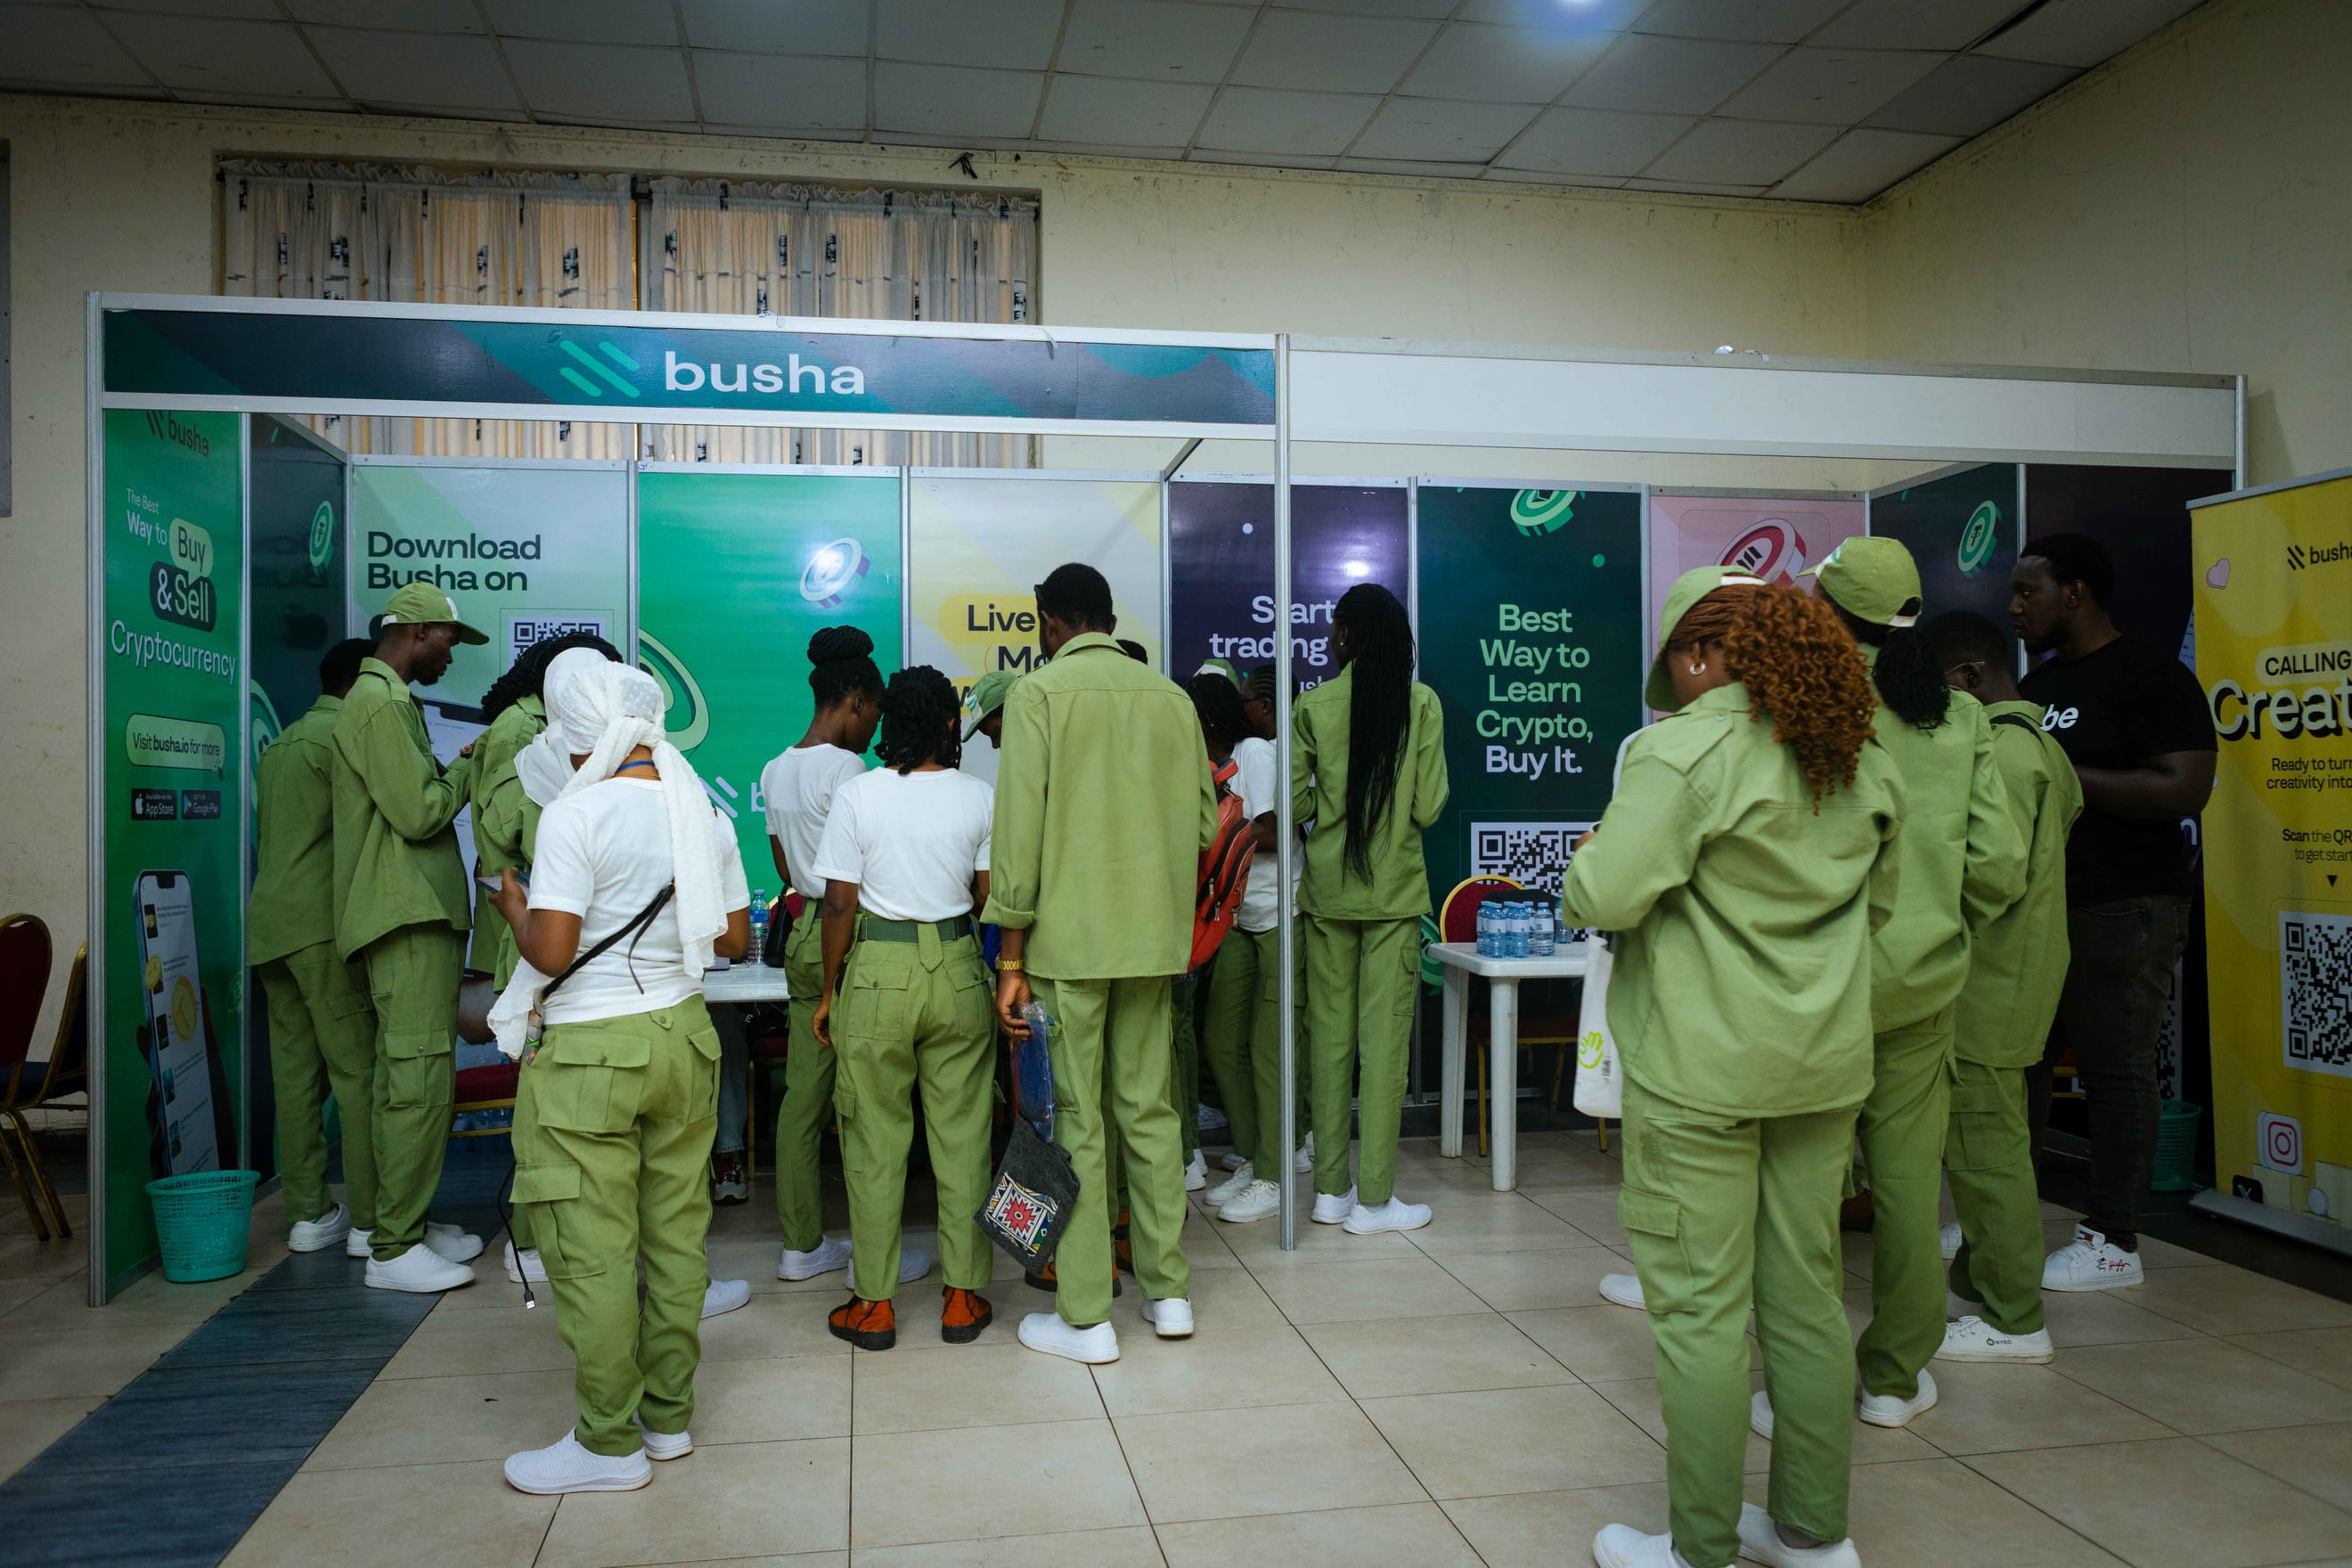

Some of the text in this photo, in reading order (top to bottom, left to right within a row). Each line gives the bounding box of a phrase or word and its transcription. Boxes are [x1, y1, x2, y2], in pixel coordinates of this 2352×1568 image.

[666, 351, 864, 395] busha
[168, 411, 209, 457] busha
[127, 487, 159, 515] The Best
[127, 510, 167, 545] Way to
[178, 527, 206, 573] Buy
[368, 531, 541, 560] Download
[2309, 542, 2352, 564] bush
[368, 562, 527, 591] Busha on
[157, 568, 208, 623] & Sell
[1252, 595, 1335, 624] Sart
[968, 603, 1036, 633] Live
[1499, 603, 1572, 633] Best
[111, 620, 236, 685] Cryptocurrency
[1209, 631, 1328, 666] tradng
[1479, 639, 1590, 675] Way to
[2265, 650, 2352, 676] CALLING
[1489, 674, 1581, 703] Learn
[1475, 709, 1594, 746] Crypto,
[133, 732, 221, 756] Visit busha.io for more
[1486, 745, 1583, 780] Buy It.
[2272, 757, 2309, 774] Ready
[2312, 758, 2326, 771] to
[2266, 775, 2325, 792] creativity
[146, 803, 175, 817] App Store
[2283, 829, 2310, 842] Scan
[2312, 829, 2332, 843] the
[2294, 848, 2305, 861] to
[2306, 849, 2324, 864] get
